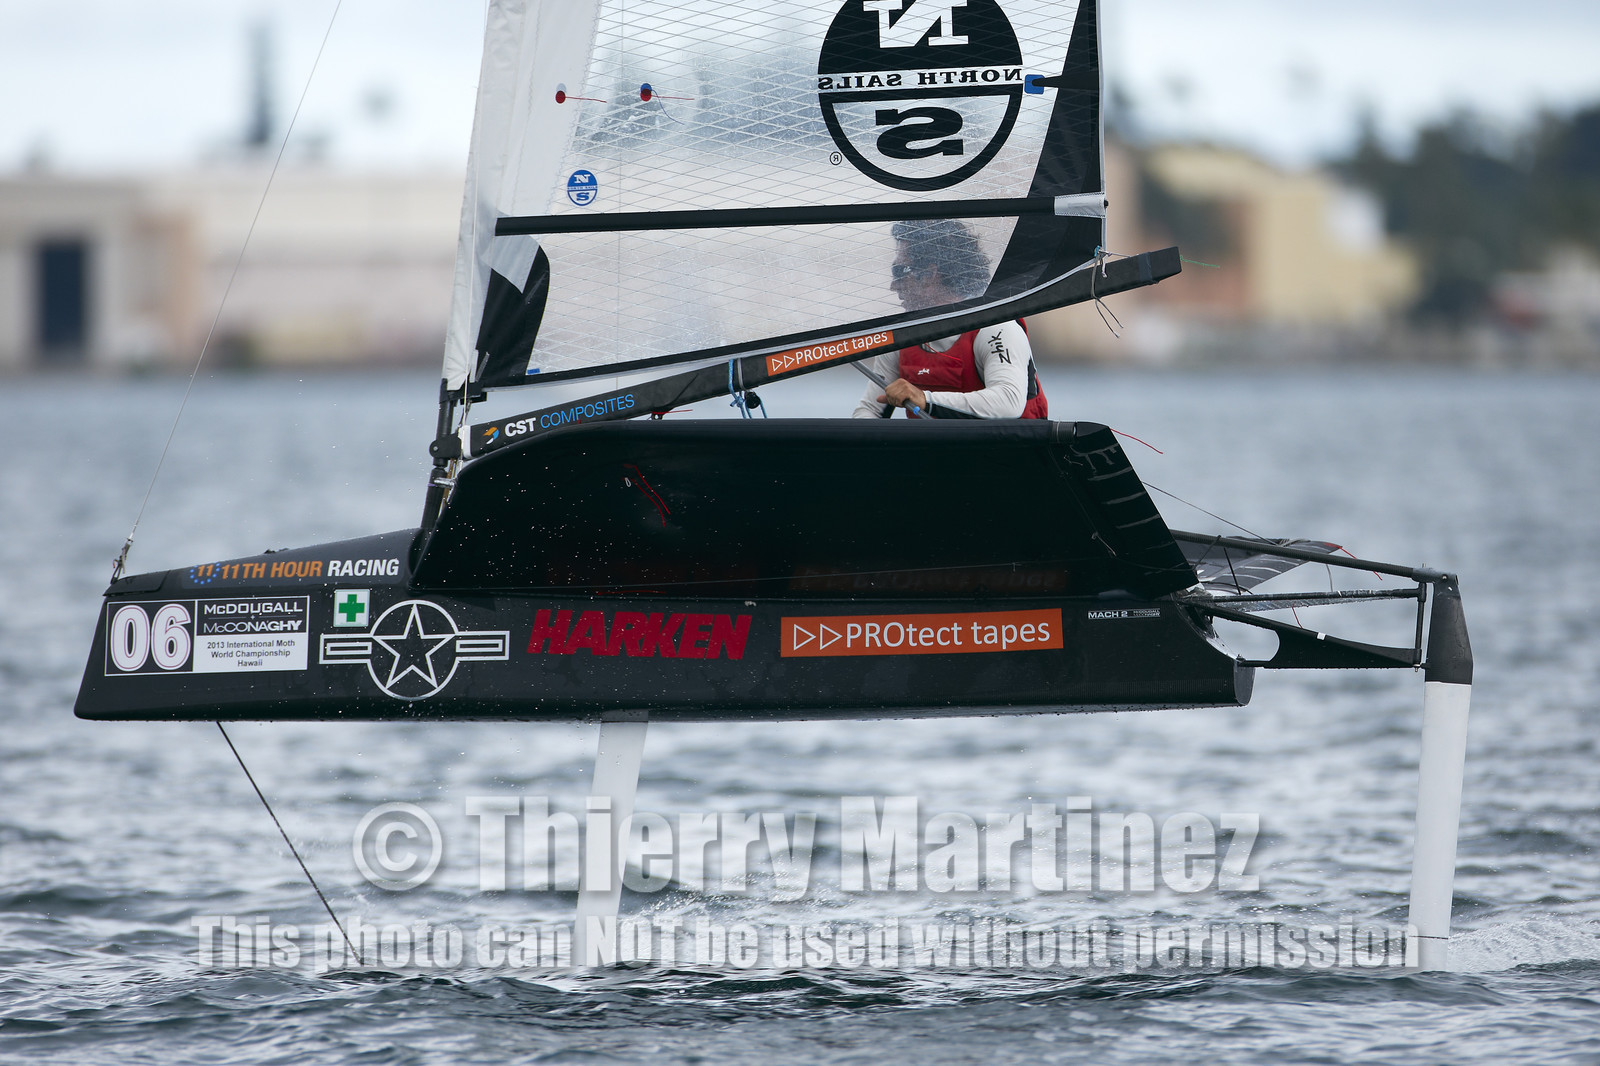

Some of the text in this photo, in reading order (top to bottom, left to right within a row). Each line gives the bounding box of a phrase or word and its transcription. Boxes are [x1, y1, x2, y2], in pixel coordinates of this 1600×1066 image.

[573, 174, 591, 184] N
[576, 192, 590, 201] S
[795, 330, 888, 368] PROtect tapes
[504, 393, 635, 438] CST COMPOSITES
[221, 558, 400, 579] 11TH HOUR RACING
[204, 602, 303, 615] McDOUGALL
[1088, 611, 1119, 619] MACH
[1121, 610, 1128, 618] 2
[203, 620, 303, 633] McCONAGHY
[110, 603, 191, 672] 06
[526, 608, 753, 661] HARKEN
[845, 618, 1051, 650] PROtect tapes
[207, 639, 295, 649] 2013 International Moth
[235, 649, 291, 659] Championship
